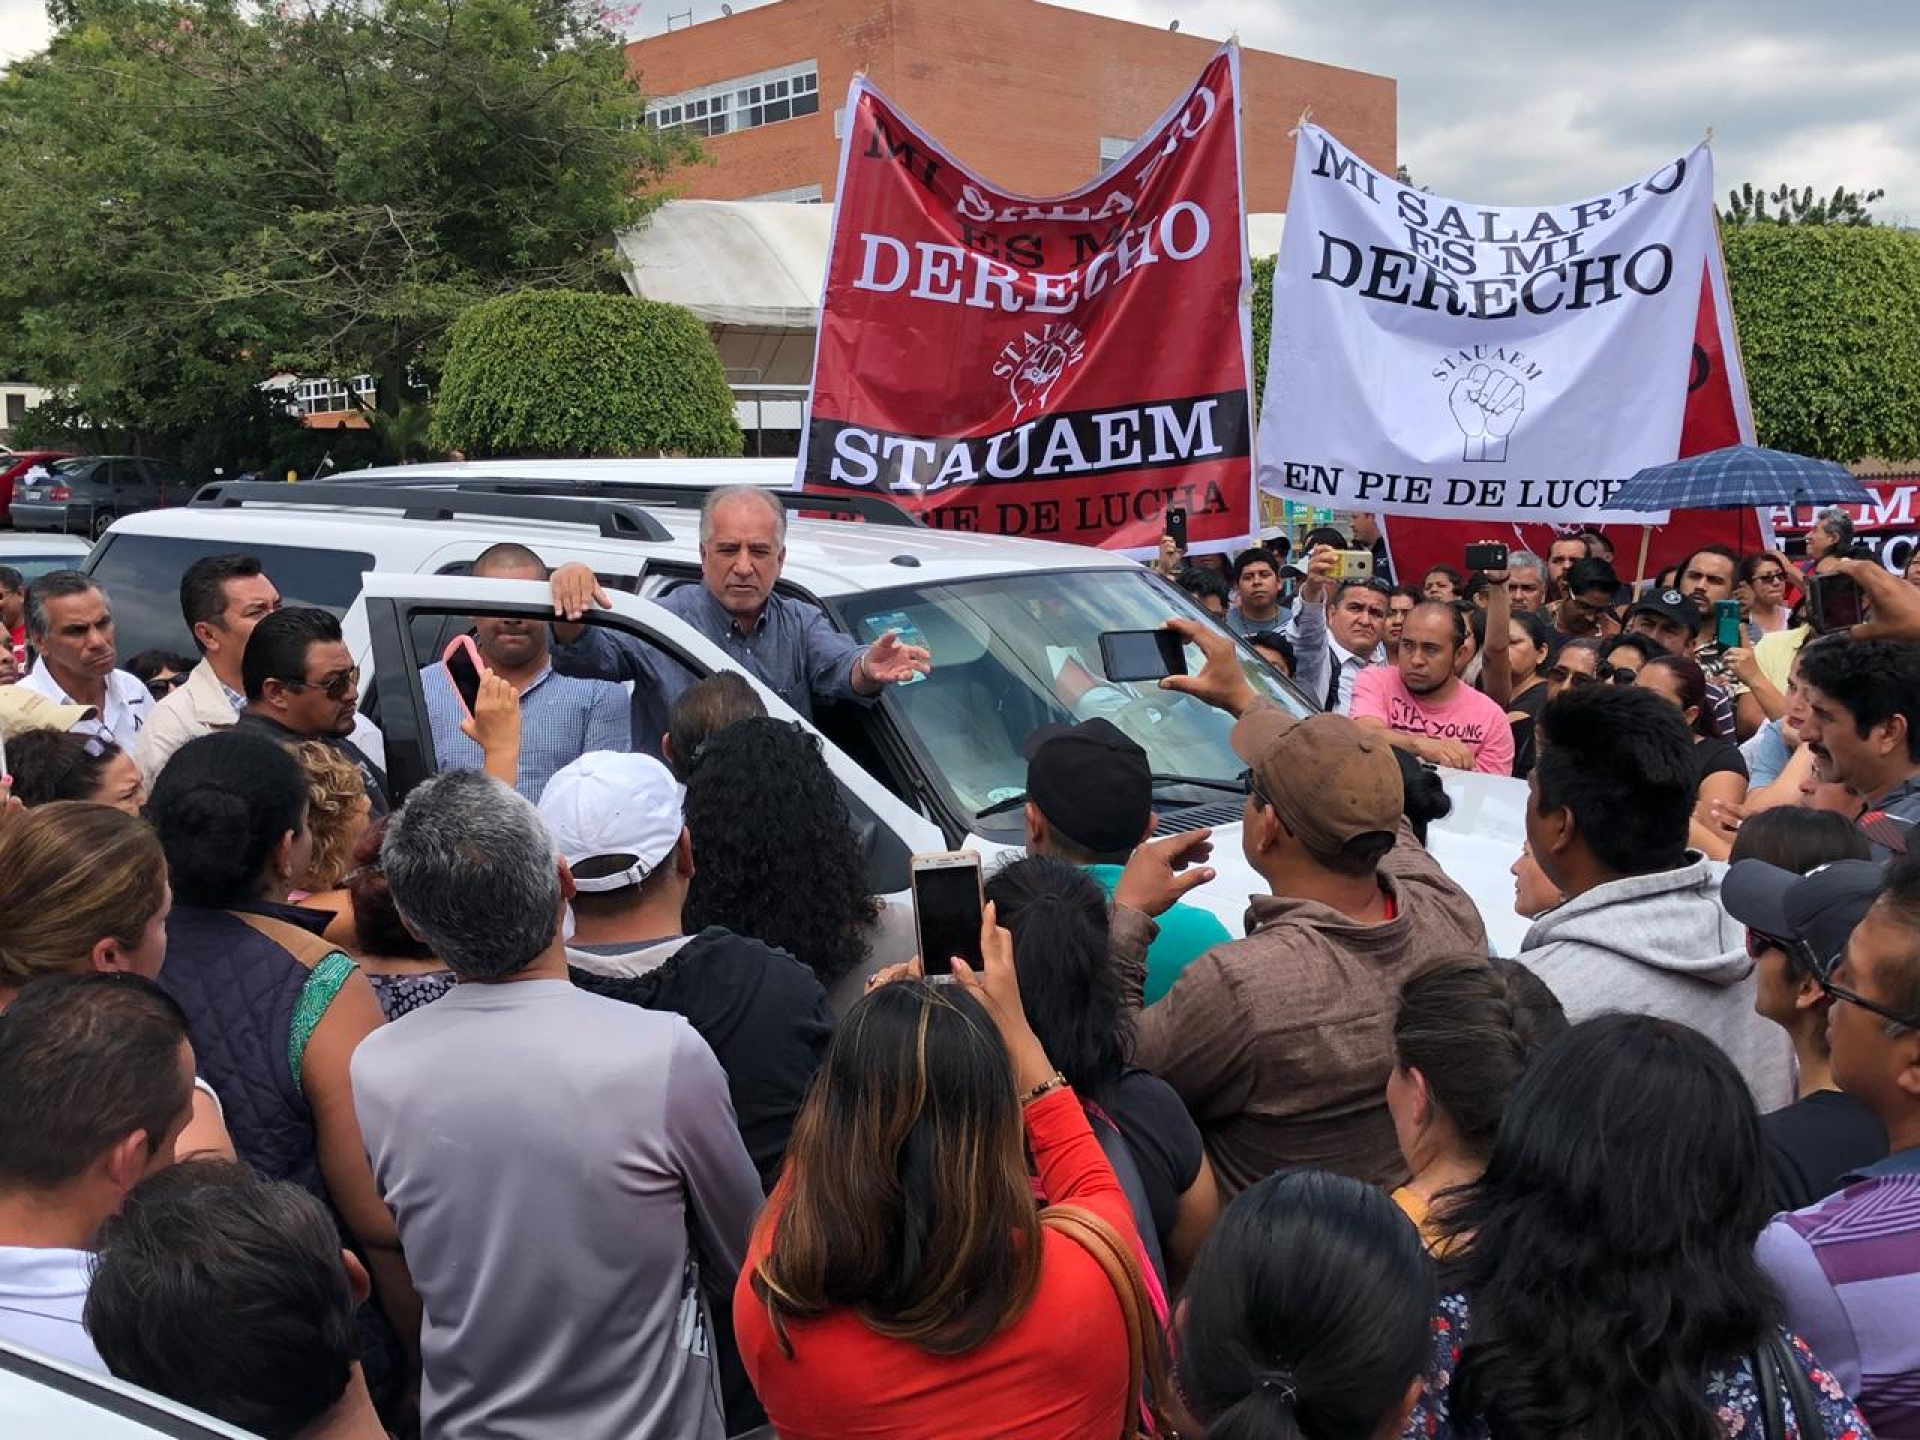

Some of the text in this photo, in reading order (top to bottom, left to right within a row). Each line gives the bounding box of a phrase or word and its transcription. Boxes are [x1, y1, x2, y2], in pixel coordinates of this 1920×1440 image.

[863, 114, 942, 191] MI
[1311, 134, 1686, 243] MI SALARIO
[853, 201, 1210, 314] DERECHO
[961, 224, 1044, 268] ES
[1405, 225, 1585, 277] ES MI
[1312, 230, 1673, 321] DERECHO
[1432, 345, 1542, 381] STAUAEM
[830, 399, 1223, 491] STAUAEM
[996, 502, 1061, 538] DE
[1075, 480, 1229, 531] LUCHA
[1283, 462, 1628, 508] EN PIE DE LUCH
[1431, 722, 1483, 740] YOUNG
